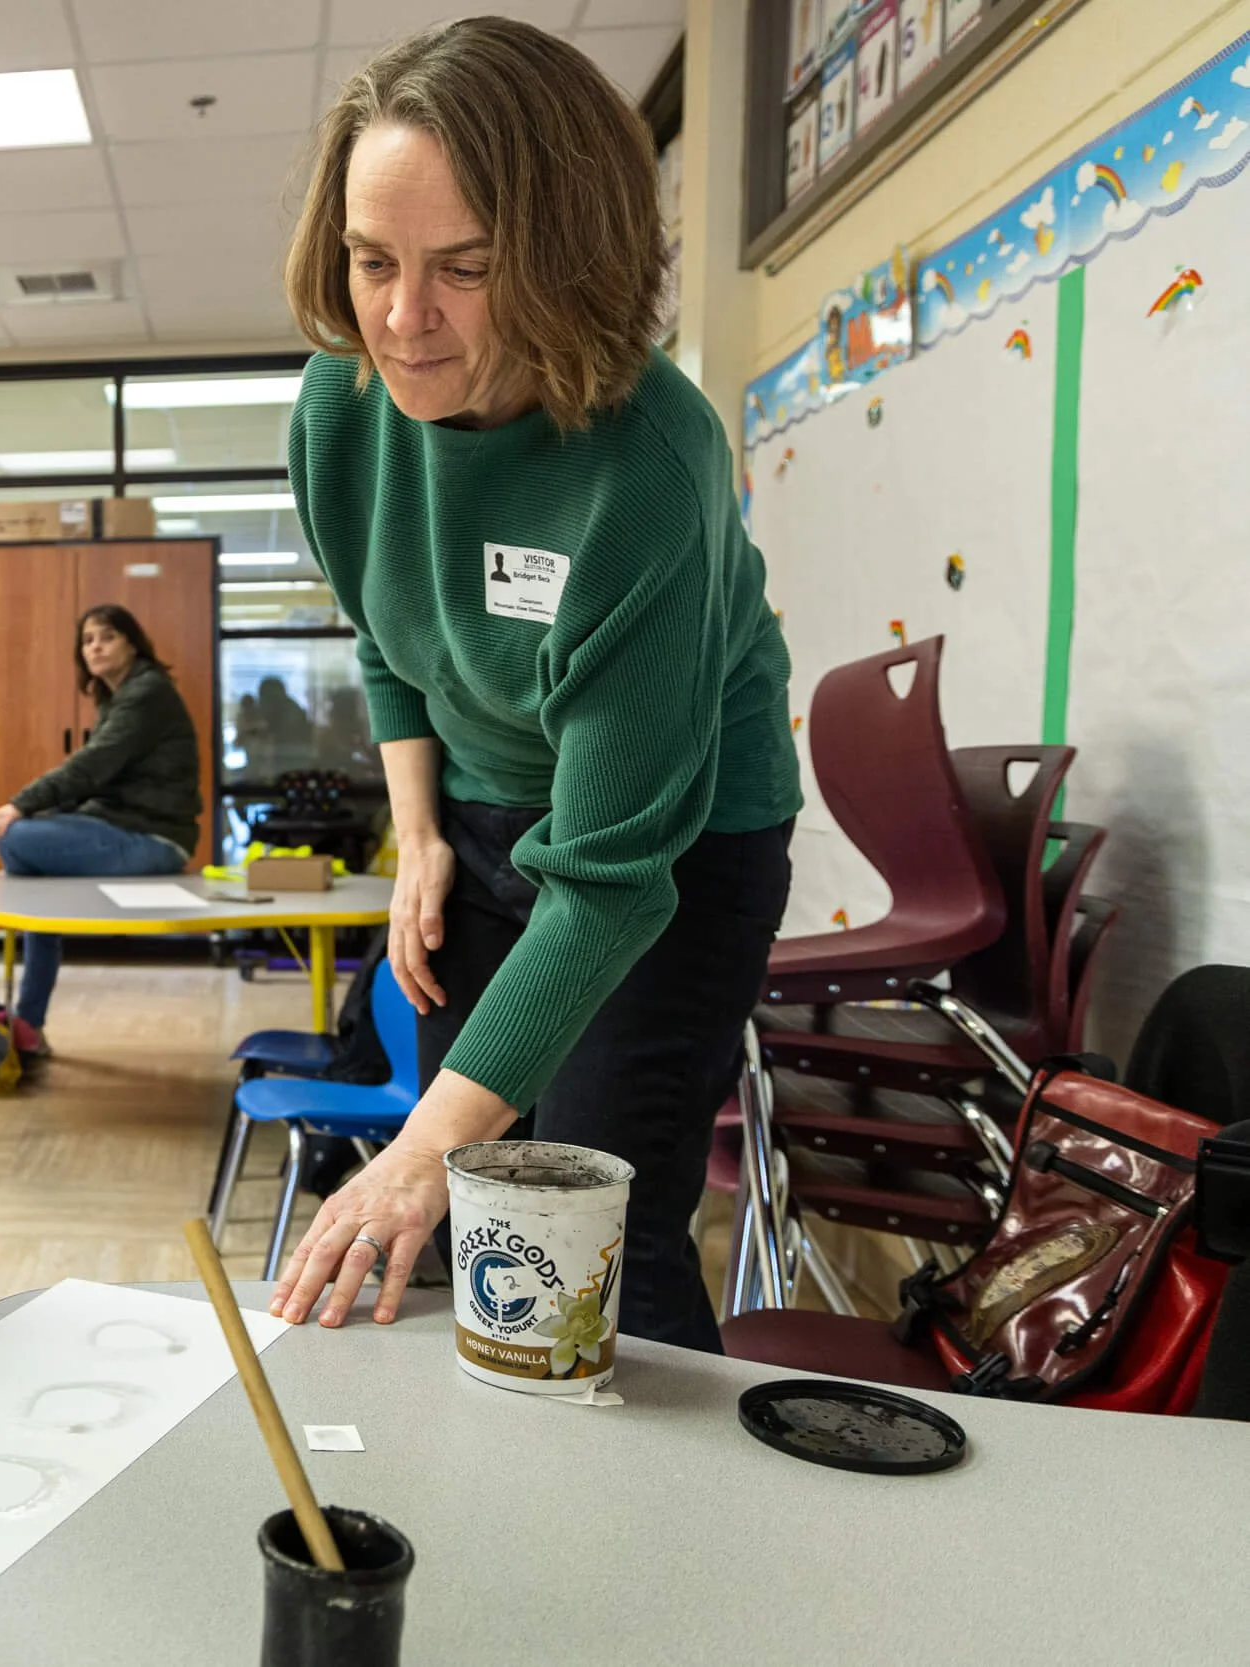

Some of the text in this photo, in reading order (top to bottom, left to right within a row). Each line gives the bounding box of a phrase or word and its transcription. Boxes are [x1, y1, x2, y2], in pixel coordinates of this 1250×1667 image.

[523, 554, 556, 568] VISITOR
[488, 1217, 511, 1230] THE
[457, 1226, 564, 1289] GREEK GODS
[469, 1300, 539, 1335] GREEK YOGURT
[466, 1336, 496, 1356] HONEY
[498, 1348, 548, 1365] VANILLA
